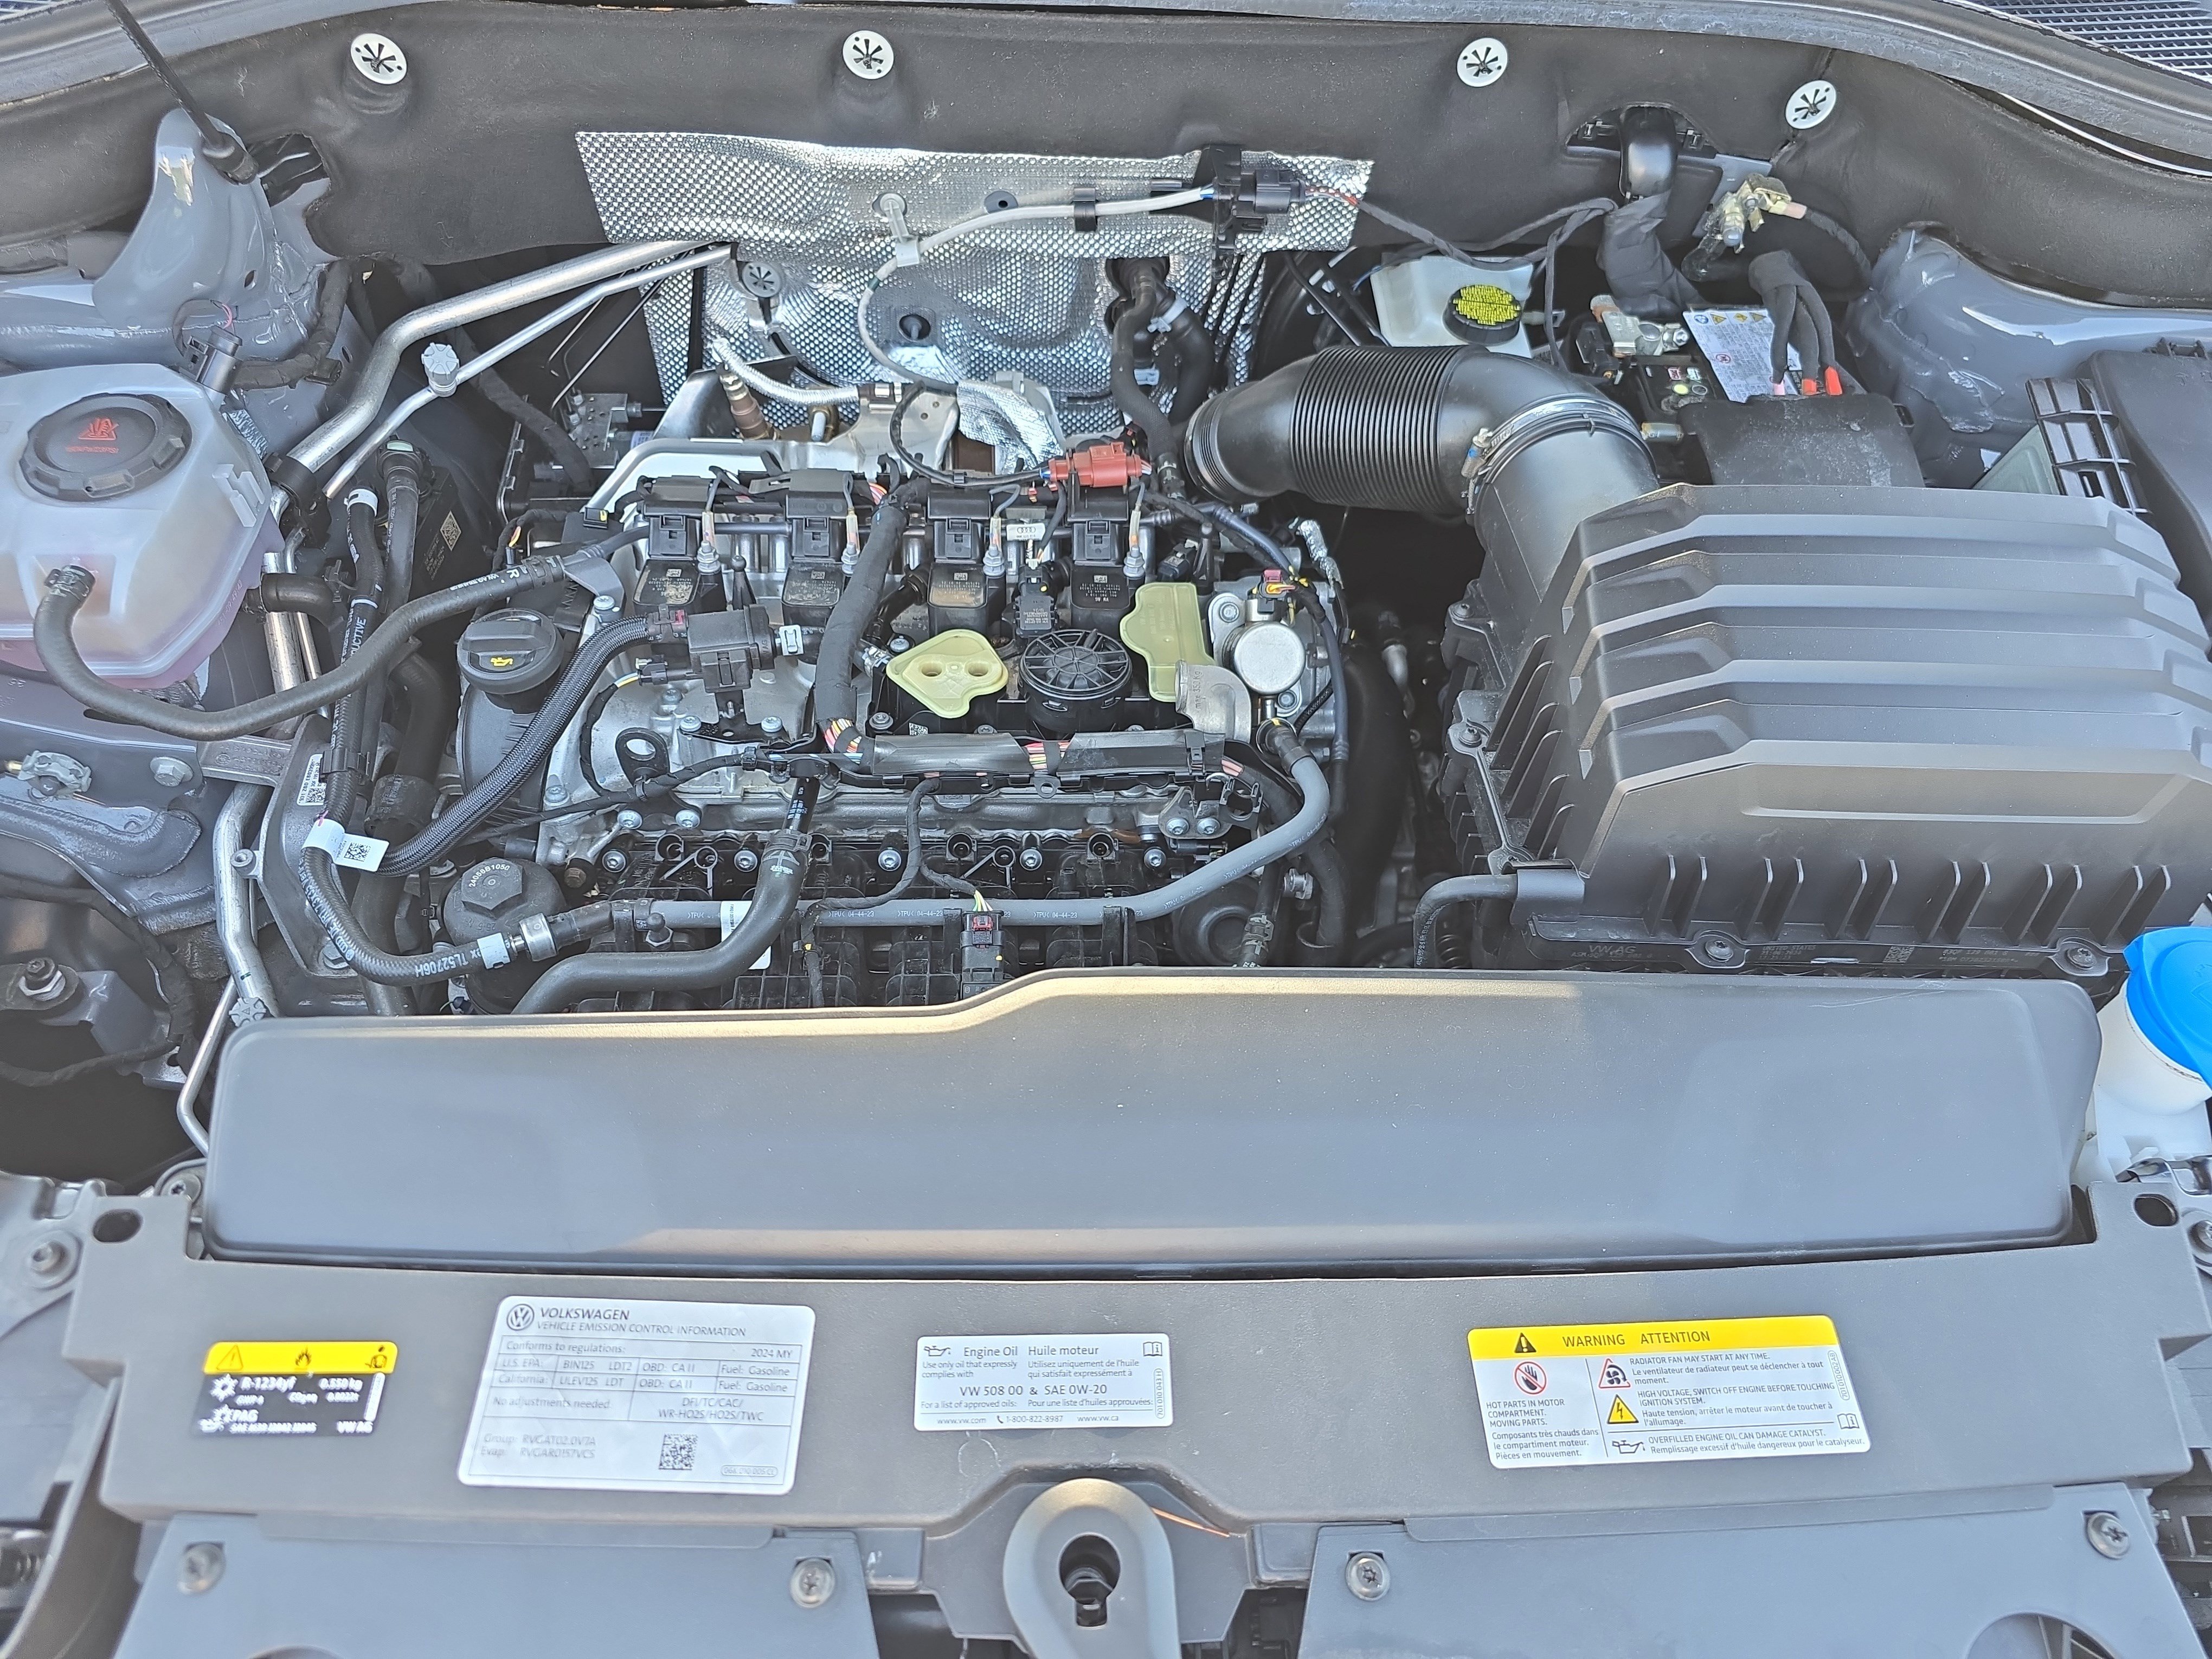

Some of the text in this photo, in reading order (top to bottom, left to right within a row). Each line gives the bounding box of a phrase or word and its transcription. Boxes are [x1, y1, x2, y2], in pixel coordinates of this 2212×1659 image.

[541, 1307, 630, 1321] VOLKSWAGEN
[537, 1321, 746, 1337] VEHICLE EMISSION CONTROL INFORMATION
[1562, 1331, 1711, 1348] WARNING ATTENTION
[506, 1340, 626, 1354] Conforms to regulations:
[964, 1346, 1018, 1359] Engine Oil
[1028, 1346, 1099, 1355] Huile moteur
[751, 1348, 793, 1359] 2024 MY
[563, 1360, 595, 1369] BIN125
[937, 1360, 953, 1369] only
[966, 1360, 981, 1368] that
[983, 1359, 1017, 1369] expressly
[1028, 1359, 1139, 1369] Utilisez uniquement de l'huile
[1630, 1357, 1667, 1366] RADIATOR
[1701, 1354, 1723, 1362] START
[721, 1364, 790, 1376] Fuel: Gasoline
[1642, 1366, 1683, 1375] ventilateur
[1696, 1365, 1730, 1373] radiateur
[1732, 1364, 1748, 1373] peut
[1761, 1361, 1799, 1370] déclencher
[922, 1370, 974, 1380] complies with
[1027, 1371, 1040, 1379] qui
[1041, 1369, 1072, 1378] satisfait
[718, 1380, 788, 1392] Fuel: Gasoline
[1635, 1377, 1669, 1385] moment.
[959, 1384, 1108, 1396] VW 508 00 & SAE 0W-20
[1637, 1390, 1656, 1398] HIGH
[1657, 1388, 1692, 1397] VOLTAGE,
[1693, 1387, 1721, 1396] SWITCH
[1739, 1385, 1766, 1393] ENGINE
[1768, 1384, 1796, 1392] BEFORE
[1797, 1382, 1835, 1392] TOUCHING
[921, 1399, 1018, 1410] For list of approved oils:
[1028, 1399, 1045, 1407] Pour
[1062, 1399, 1077, 1407] liste
[1079, 1398, 1107, 1406] d'huiles
[1108, 1398, 1154, 1408] approuvées:
[1486, 1401, 1501, 1409] HOT
[1503, 1400, 1526, 1408] PARTS
[1538, 1398, 1565, 1406] MOTOR
[1639, 1397, 1706, 1407] IGNITION SYSTEM.
[1488, 1409, 1547, 1418] COMPARTMENT.
[1642, 1409, 1665, 1418] Haute
[1667, 1408, 1697, 1417] tension,
[1699, 1406, 1724, 1415] arrêter
[1735, 1405, 1762, 1413] moteur
[1797, 1402, 1827, 1411] toucher
[1006, 1415, 1063, 1424] 1-800-822-8987
[1490, 1418, 1547, 1427] MOVING PARTS.
[1644, 1418, 1686, 1427] l'allumage.
[1492, 1427, 1599, 1441] Composants très chauds dans
[1648, 1429, 1826, 1444] OVERFILLED ENGINE OIL CAN DAMAGE CATALYST.
[1503, 1440, 1557, 1451] compartiment
[1559, 1439, 1589, 1447] moteur.
[1650, 1437, 1865, 1455] Remplissage excessif d'huile dangereux pour le catalyseur.
[1496, 1451, 1520, 1459] Pièces
[1533, 1450, 1581, 1458] mouvement.
